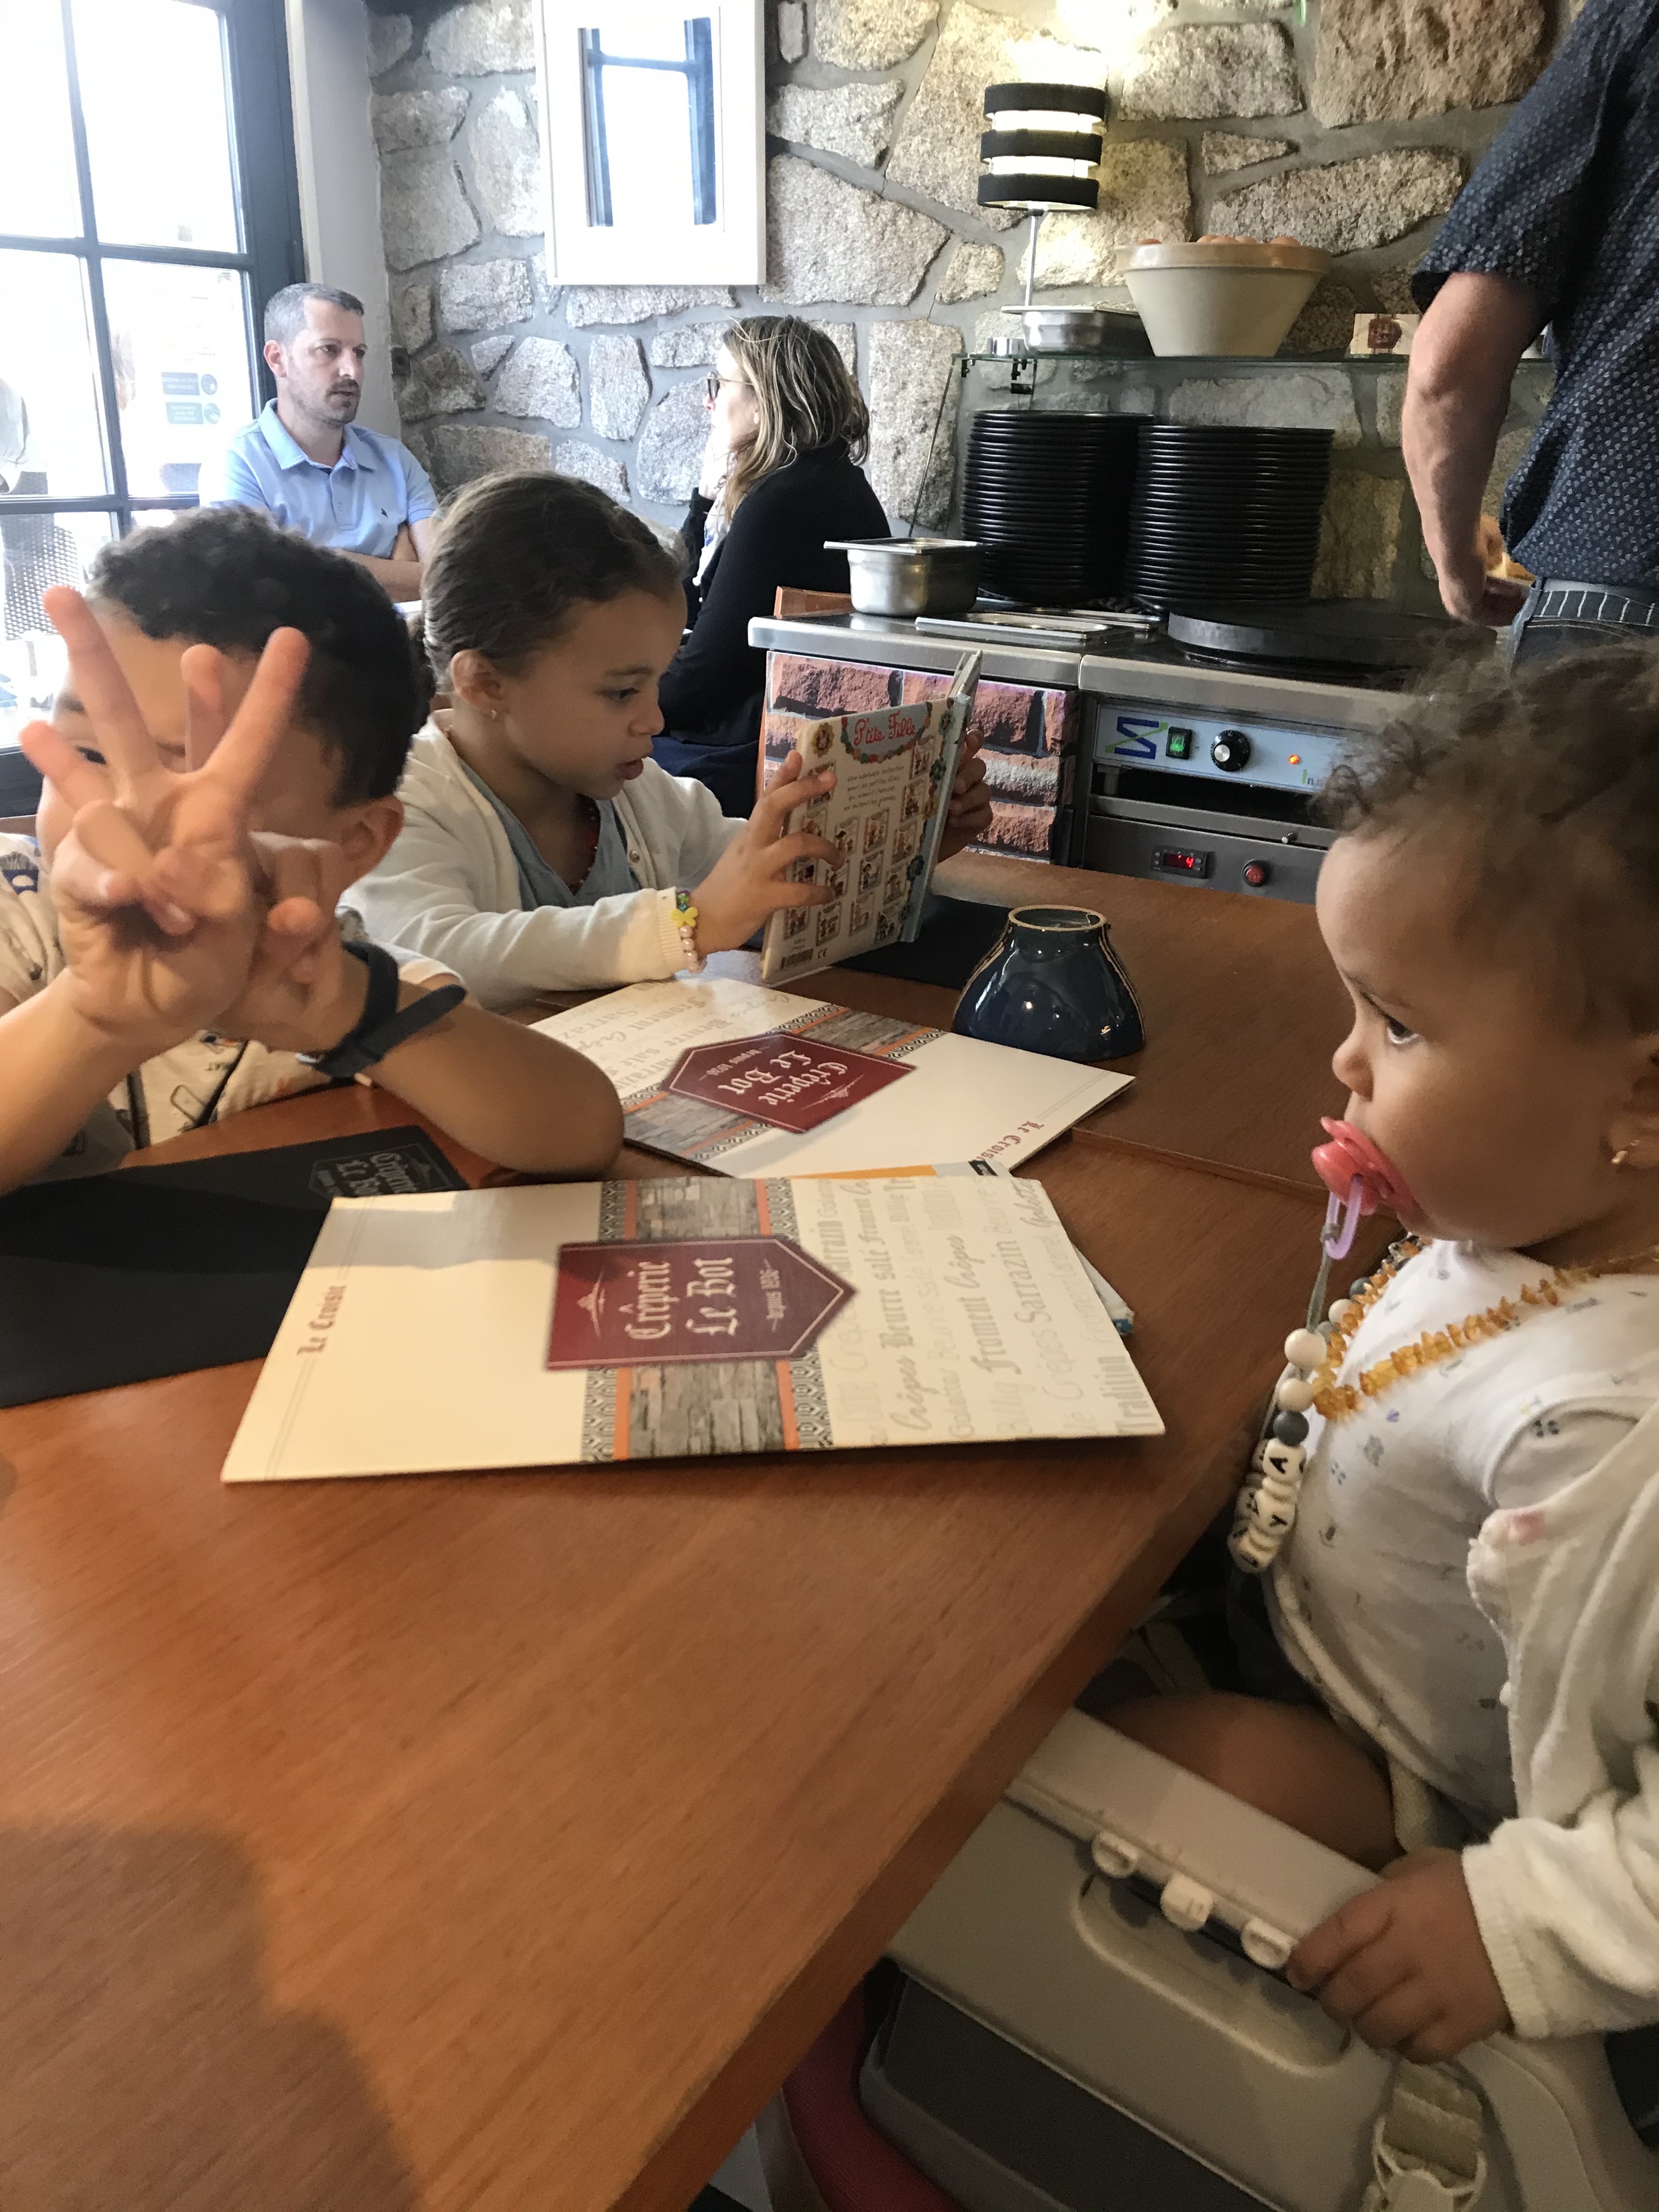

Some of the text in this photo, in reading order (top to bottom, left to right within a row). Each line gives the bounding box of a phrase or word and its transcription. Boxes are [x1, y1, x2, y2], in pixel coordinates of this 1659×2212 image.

[888, 710, 916, 739] Fille
[769, 1050, 812, 1069] Le
[757, 1061, 849, 1106] Crêperie
[1017, 1121, 1045, 1133] Le
[618, 1260, 680, 1340] Crêperie
[686, 1256, 740, 1338] Le Bot
[296, 1336, 327, 1356] Le
